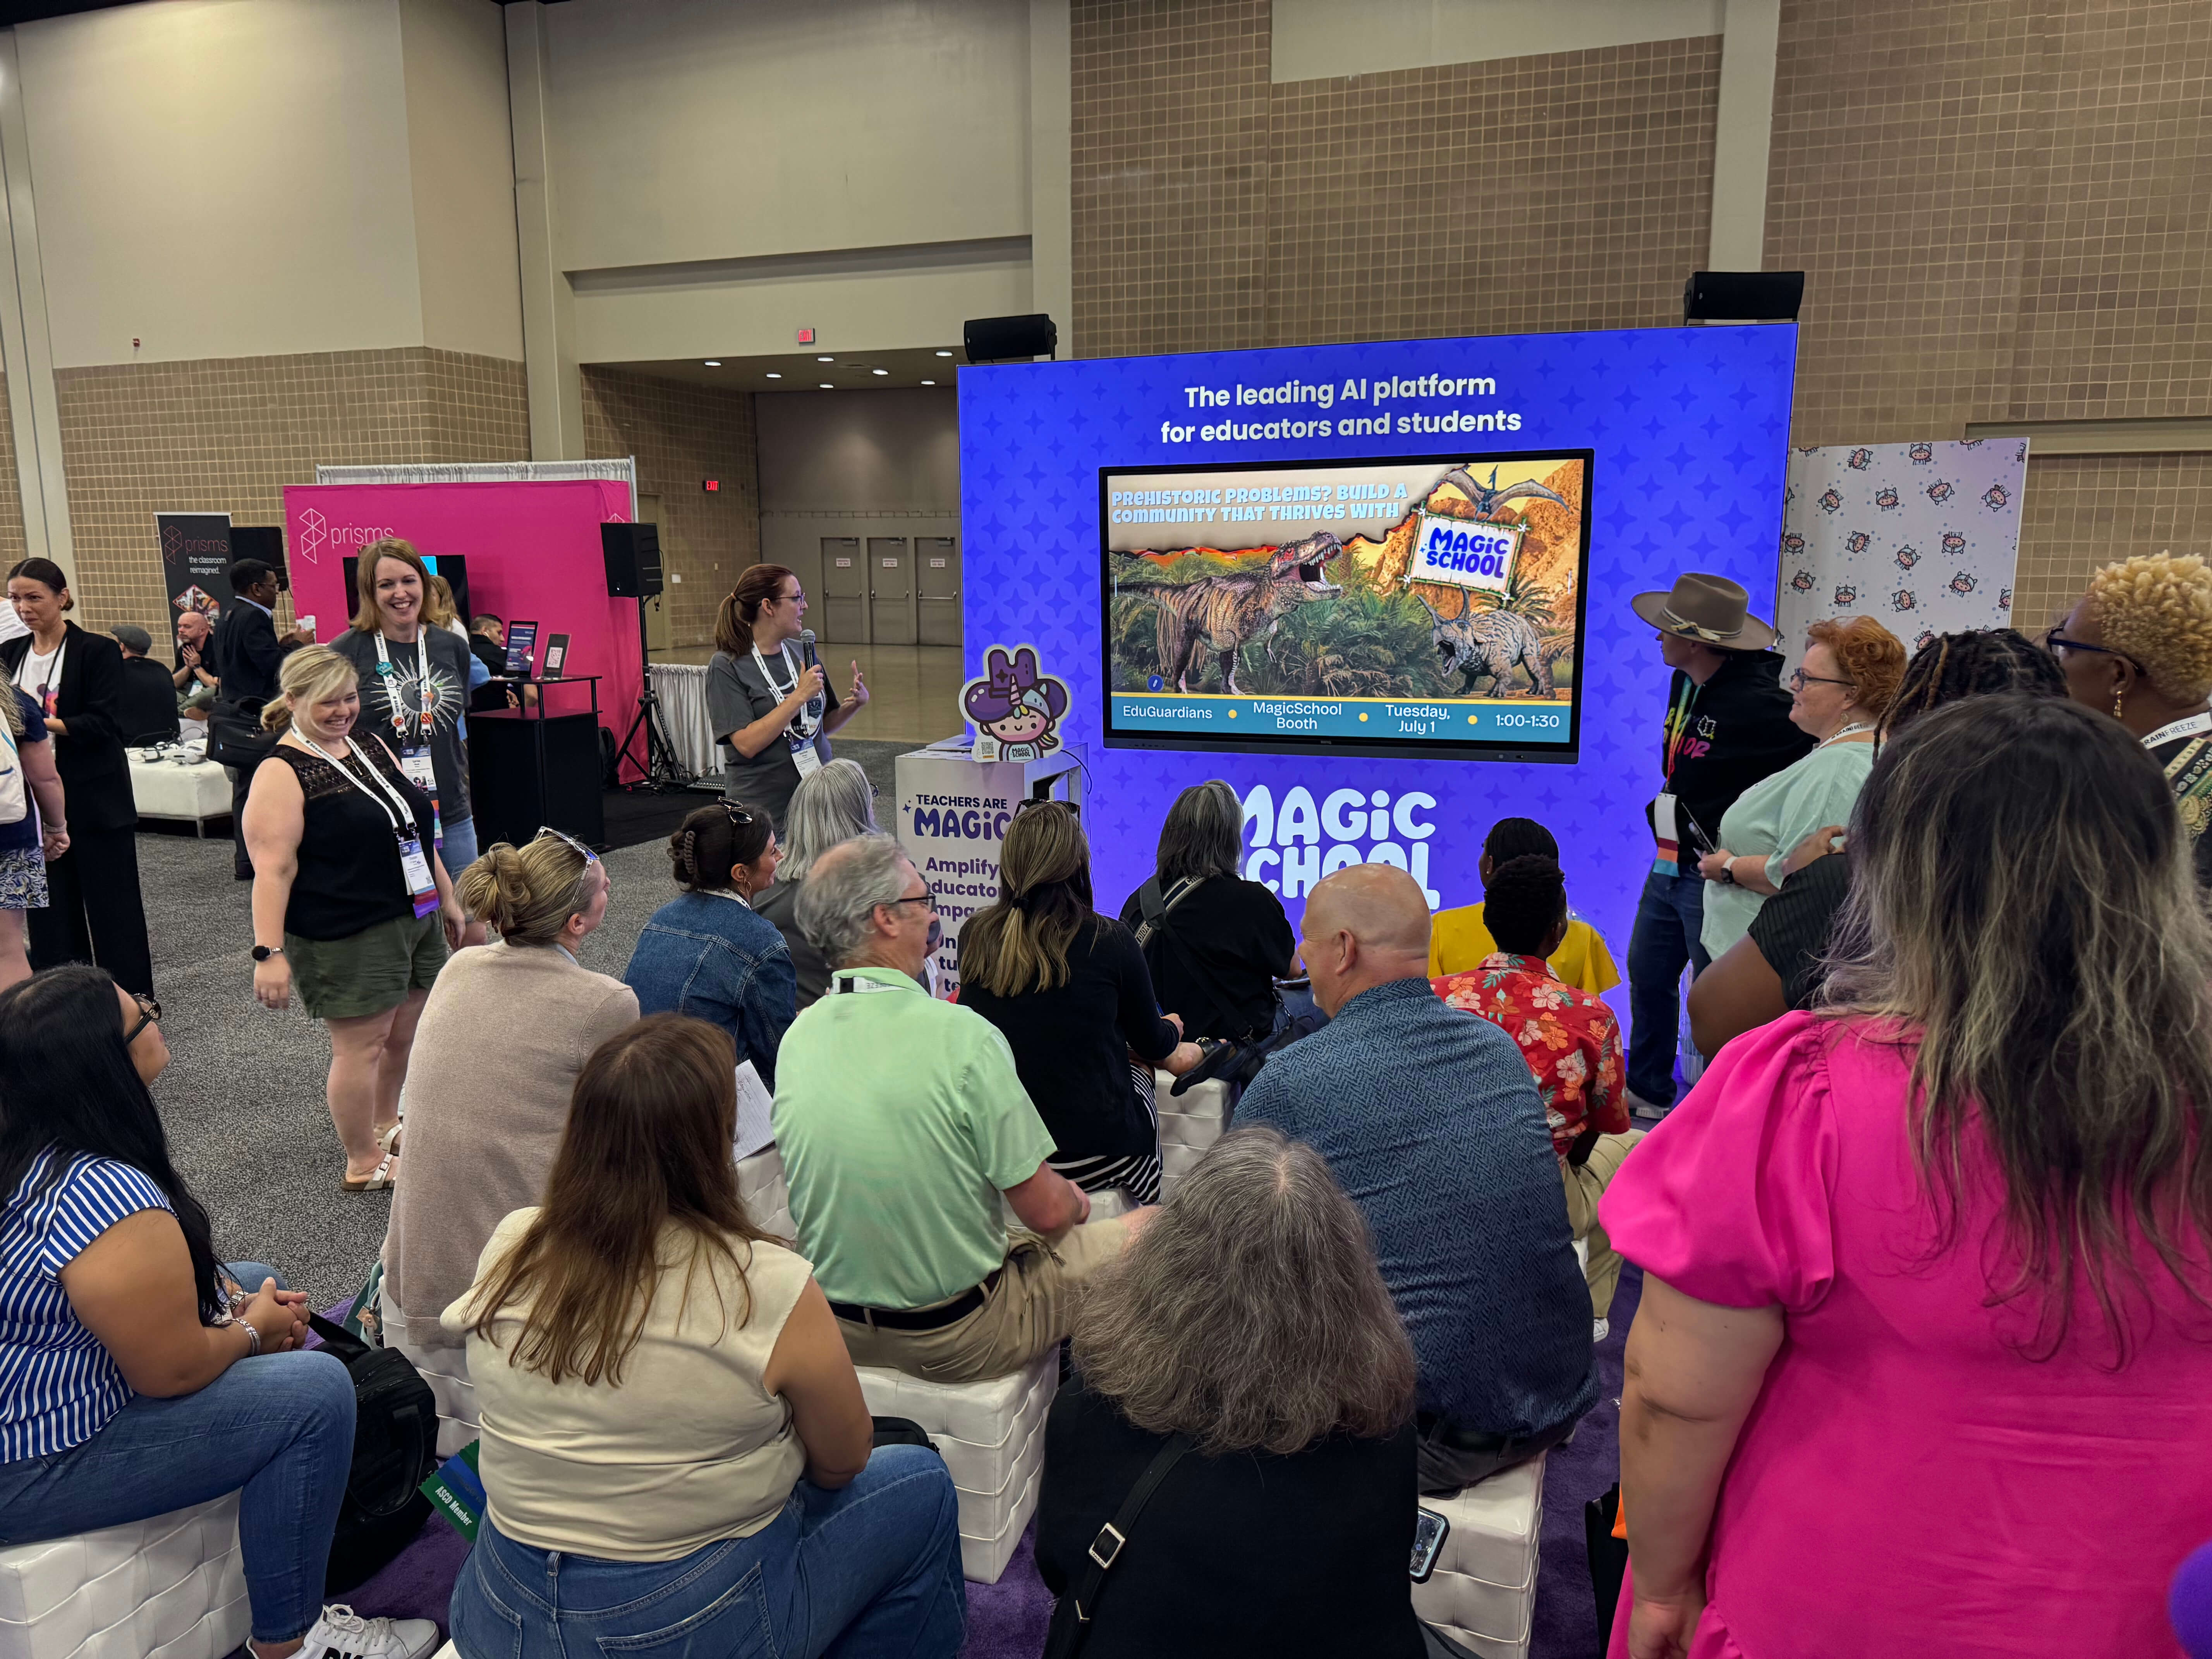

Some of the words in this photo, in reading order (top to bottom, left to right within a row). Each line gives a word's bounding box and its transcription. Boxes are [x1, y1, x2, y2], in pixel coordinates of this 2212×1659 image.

[1185, 386, 1230, 408] The
[1237, 380, 1334, 409] leading
[1340, 378, 1367, 400] AI
[1374, 373, 1496, 406] platform
[1161, 421, 1195, 443] for
[1200, 417, 1332, 441] educators
[1338, 412, 1390, 436] and
[1397, 410, 1522, 434] students
[707, 481, 718, 491] EXIT
[1112, 489, 1221, 506] PREHISTORIC
[1225, 486, 1332, 503] PROBLEMS?
[1337, 484, 1390, 501] BUILD
[1394, 483, 1407, 499] A
[1112, 508, 1217, 524] COMMUNITY
[1221, 507, 1266, 522] THAT
[1269, 504, 1346, 521] THRIVES
[1350, 502, 1399, 519] WITH
[331, 522, 394, 549] prisms
[185, 536, 228, 555] prisms
[199, 556, 227, 564] classroom
[1426, 551, 1504, 579] SCHOOL
[1123, 705, 1212, 719] EduGuardians
[1253, 702, 1342, 716] MagicSchool
[1386, 704, 1451, 720] Tuesday,
[1276, 717, 1317, 730] Booth
[1398, 720, 1426, 735] July
[1430, 721, 1435, 733] 1
[1496, 714, 1559, 728] 1:00-1:30
[2144, 722, 2198, 745] RAINFREEZE
[916, 794, 981, 808] TEACHERS
[983, 798, 1007, 809] ARE
[926, 857, 999, 880] Amplify
[1239, 842, 1440, 910] CHL
[927, 879, 1000, 898] ducato
[1137, 924, 1150, 942] DIOR
[435, 1486, 453, 1504] ASCD
[448, 1500, 472, 1526] Member
